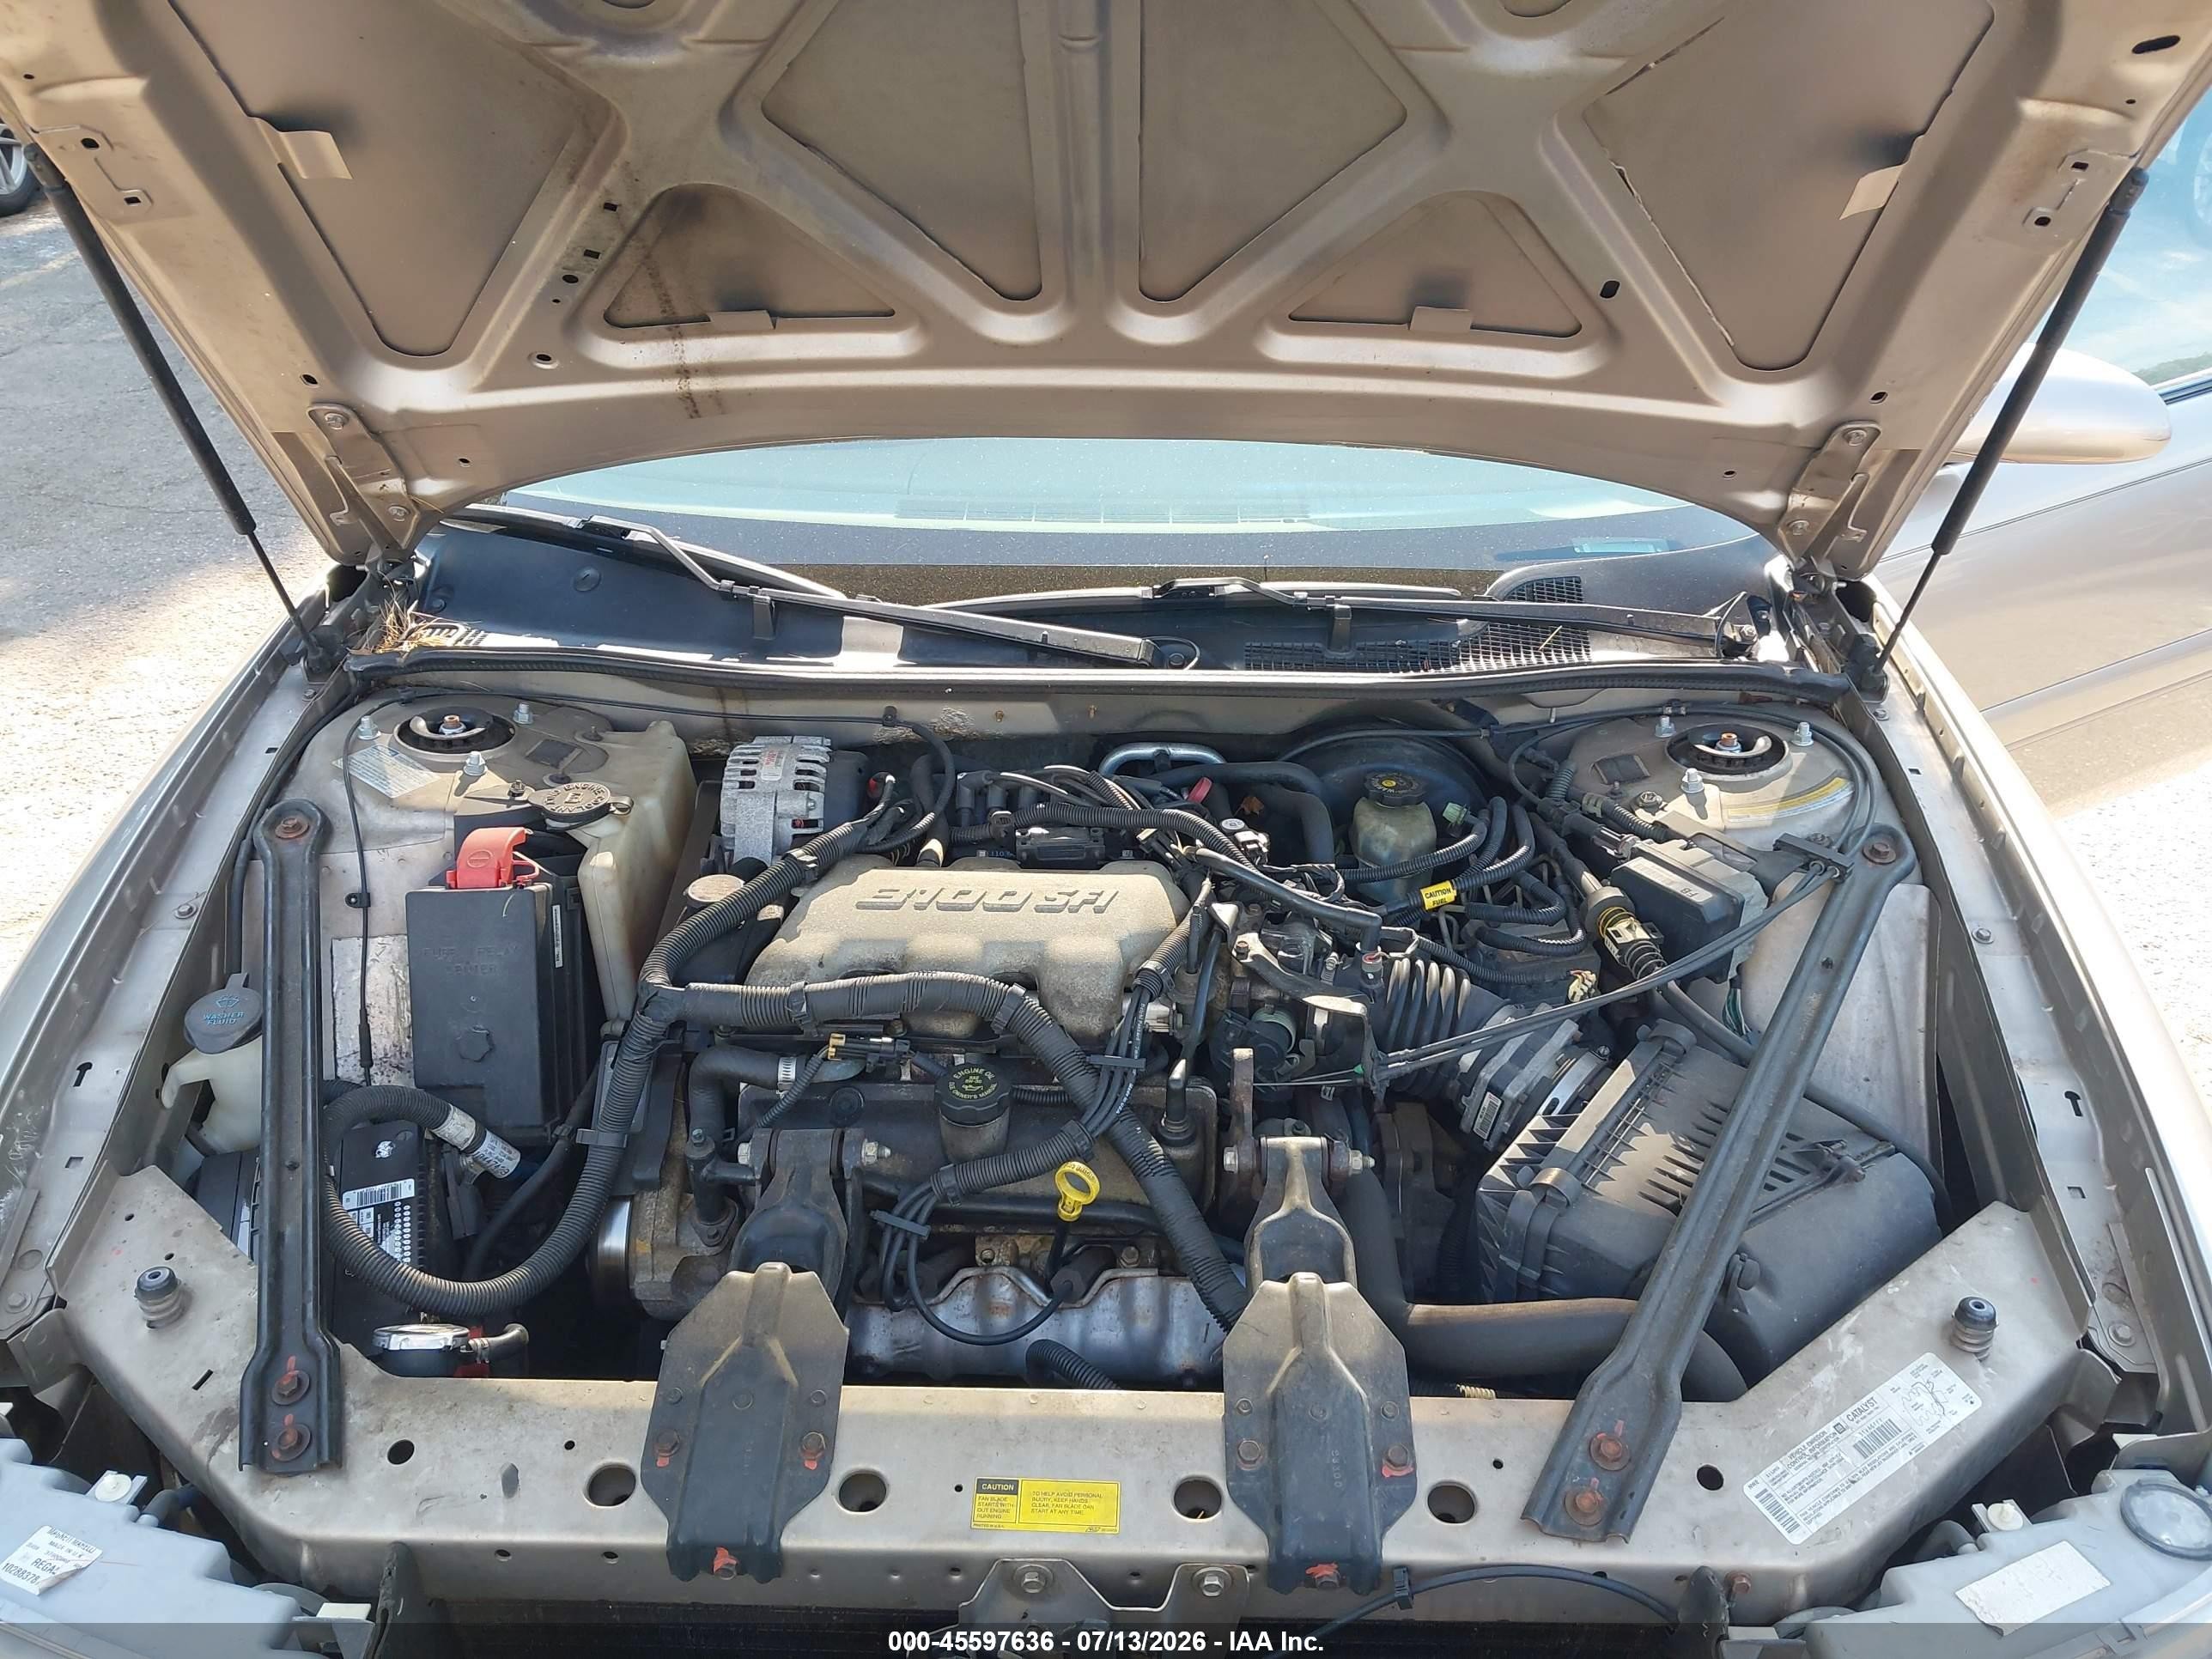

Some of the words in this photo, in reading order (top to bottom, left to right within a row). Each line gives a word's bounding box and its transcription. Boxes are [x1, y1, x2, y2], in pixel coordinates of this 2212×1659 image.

[1425, 888, 1451, 899] CAUTION
[855, 887, 1033, 912] 3100
[1034, 889, 1120, 915] SFI
[1432, 897, 1447, 906] FUEL
[203, 1012, 245, 1021] WASHER
[953, 1067, 985, 1079] ENGINE
[985, 1072, 995, 1080] OIL
[1846, 1396, 1878, 1421] CATALYST
[1786, 1451, 1808, 1469] CONTROL
